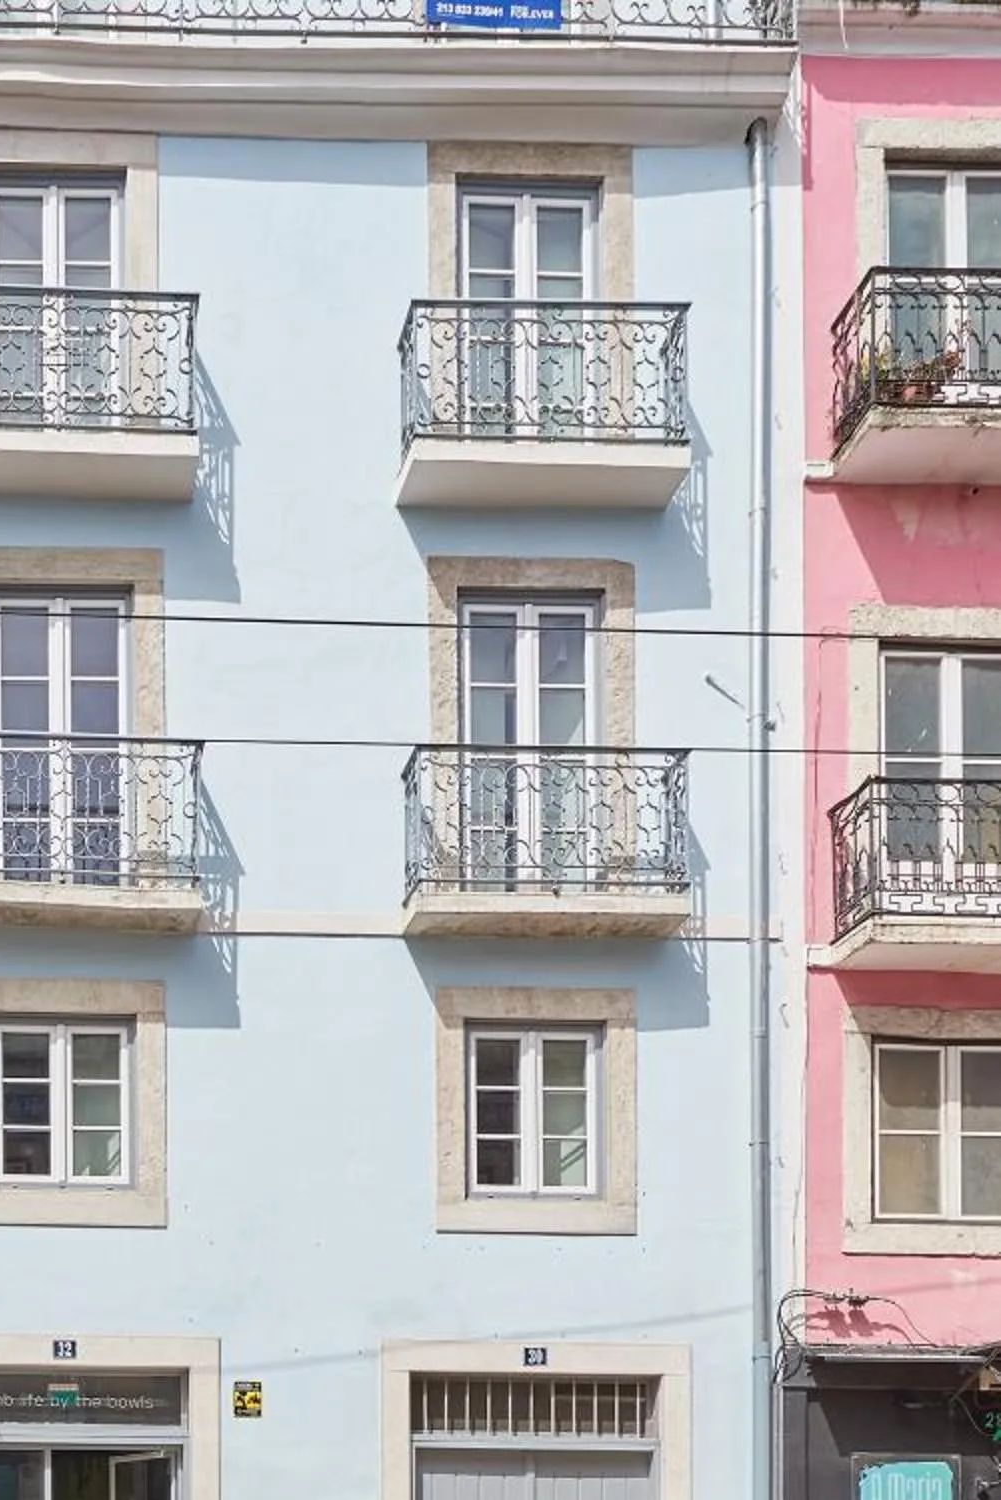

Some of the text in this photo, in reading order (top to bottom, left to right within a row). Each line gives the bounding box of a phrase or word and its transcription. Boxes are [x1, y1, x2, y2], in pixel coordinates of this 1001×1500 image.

[50, 1395, 69, 1410] by
[76, 1395, 103, 1408] the
[108, 1395, 154, 1410] bowls
